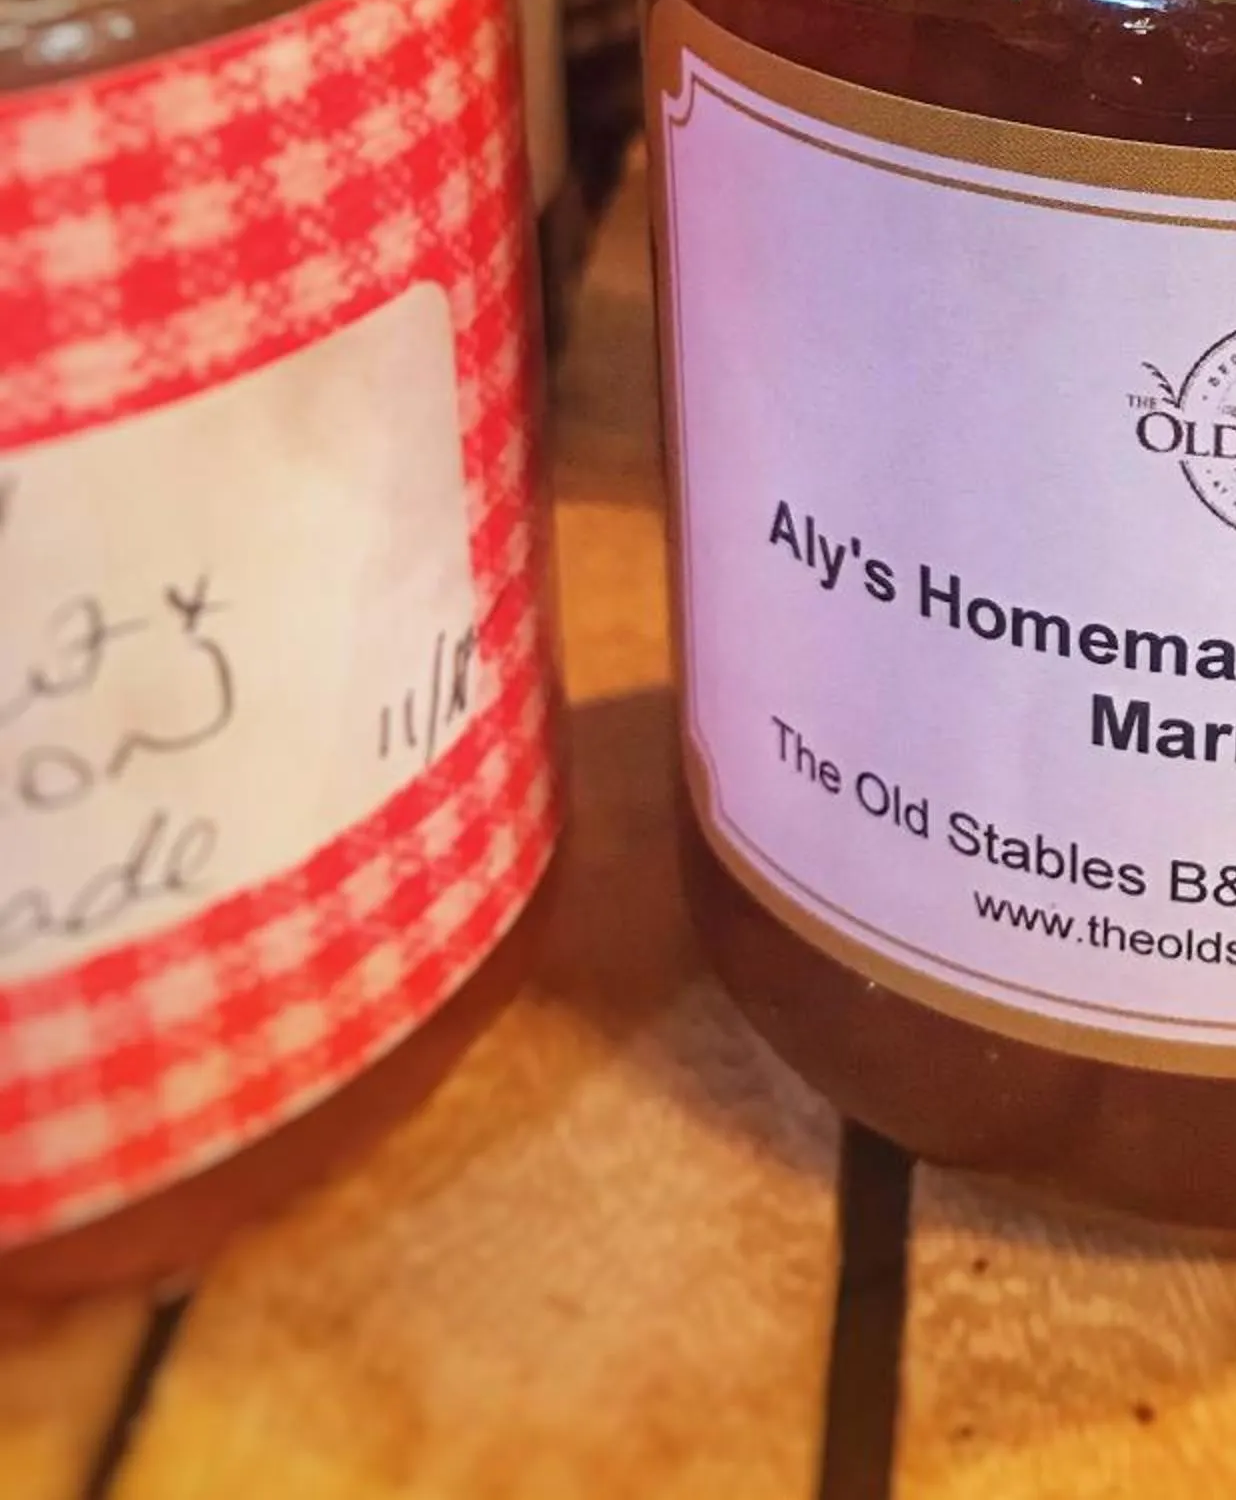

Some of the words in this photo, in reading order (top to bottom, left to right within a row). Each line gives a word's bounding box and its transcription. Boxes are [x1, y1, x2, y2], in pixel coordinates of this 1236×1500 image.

[1127, 393, 1157, 409] THE
[768, 500, 897, 602] Aly's
[770, 714, 843, 796] The
[855, 770, 930, 839] Old
[947, 810, 1147, 897] Stables
